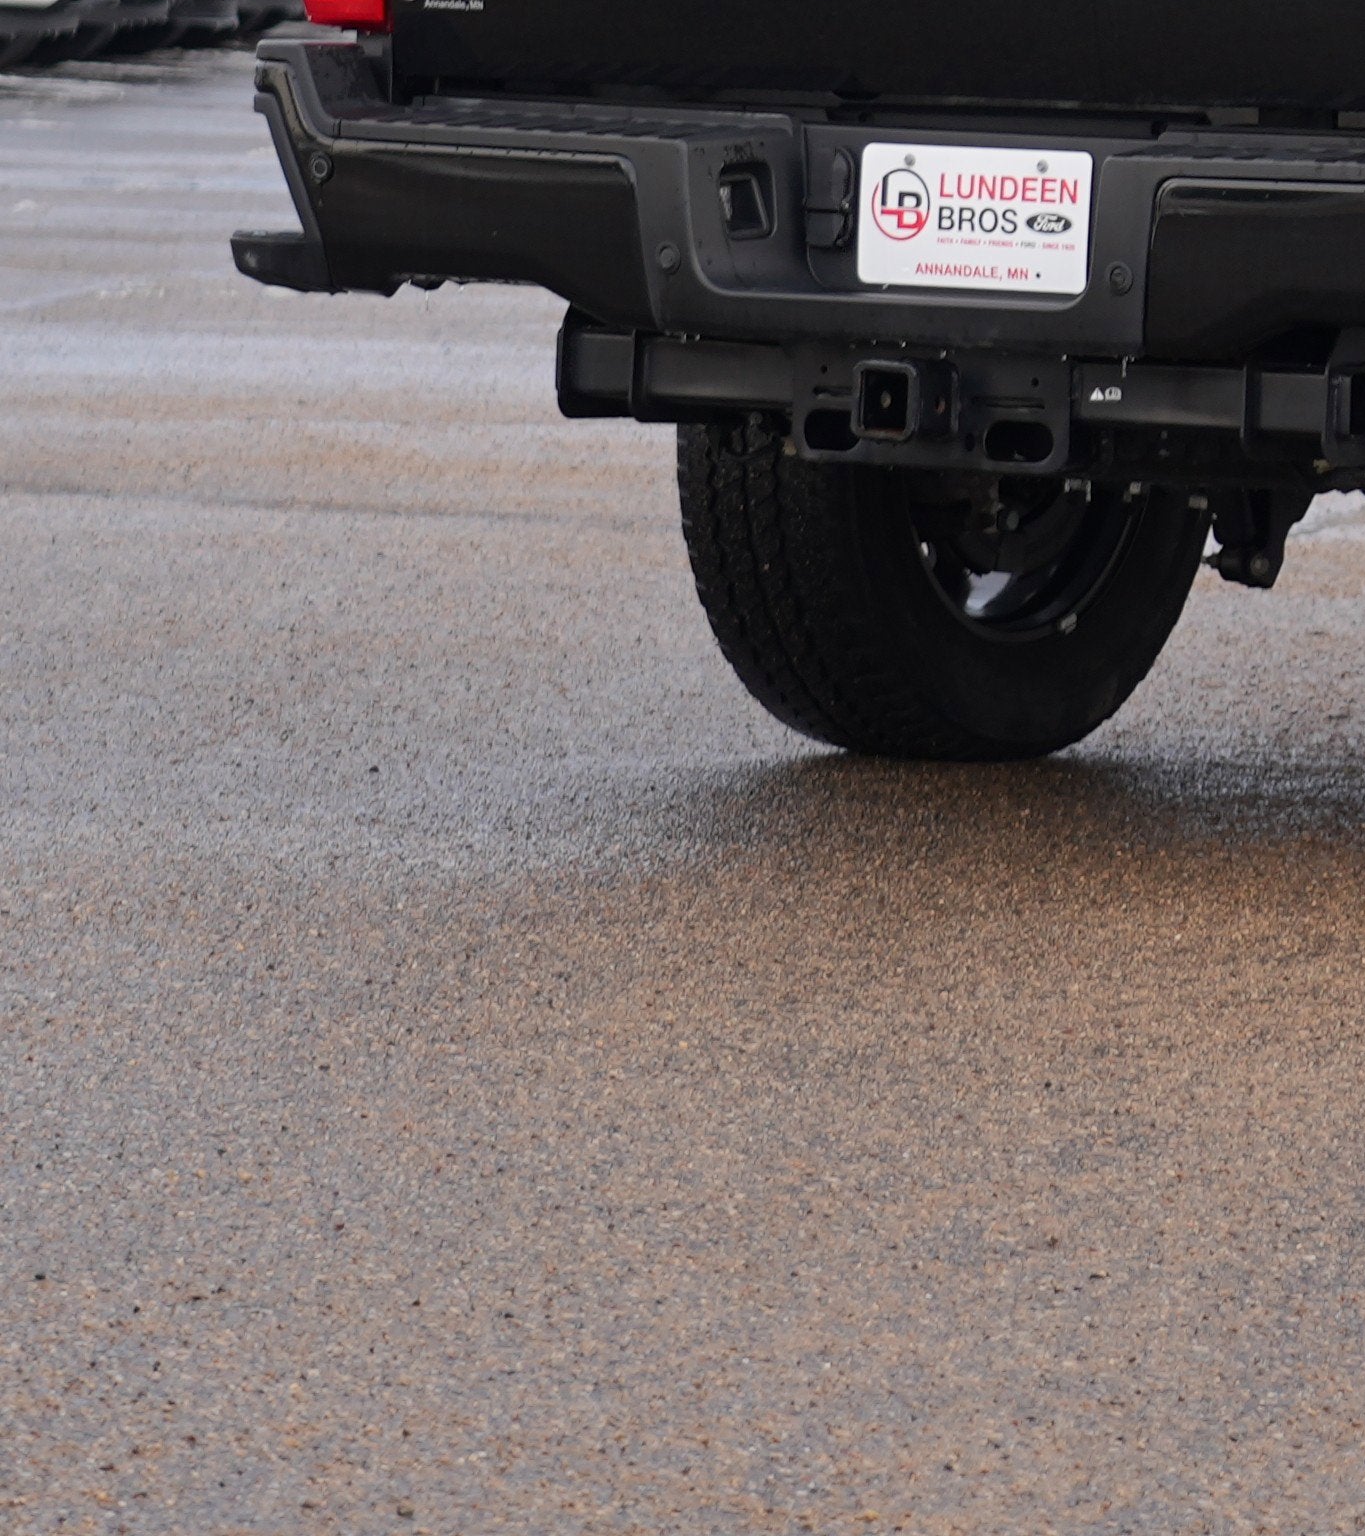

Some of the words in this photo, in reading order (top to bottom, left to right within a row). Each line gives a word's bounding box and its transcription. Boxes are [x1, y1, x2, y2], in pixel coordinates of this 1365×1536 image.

[939, 173, 1078, 204] LUNDEEN
[938, 206, 1018, 234] BROS
[915, 262, 1002, 281] ANNANDALE,
[1007, 265, 1028, 280] MN
